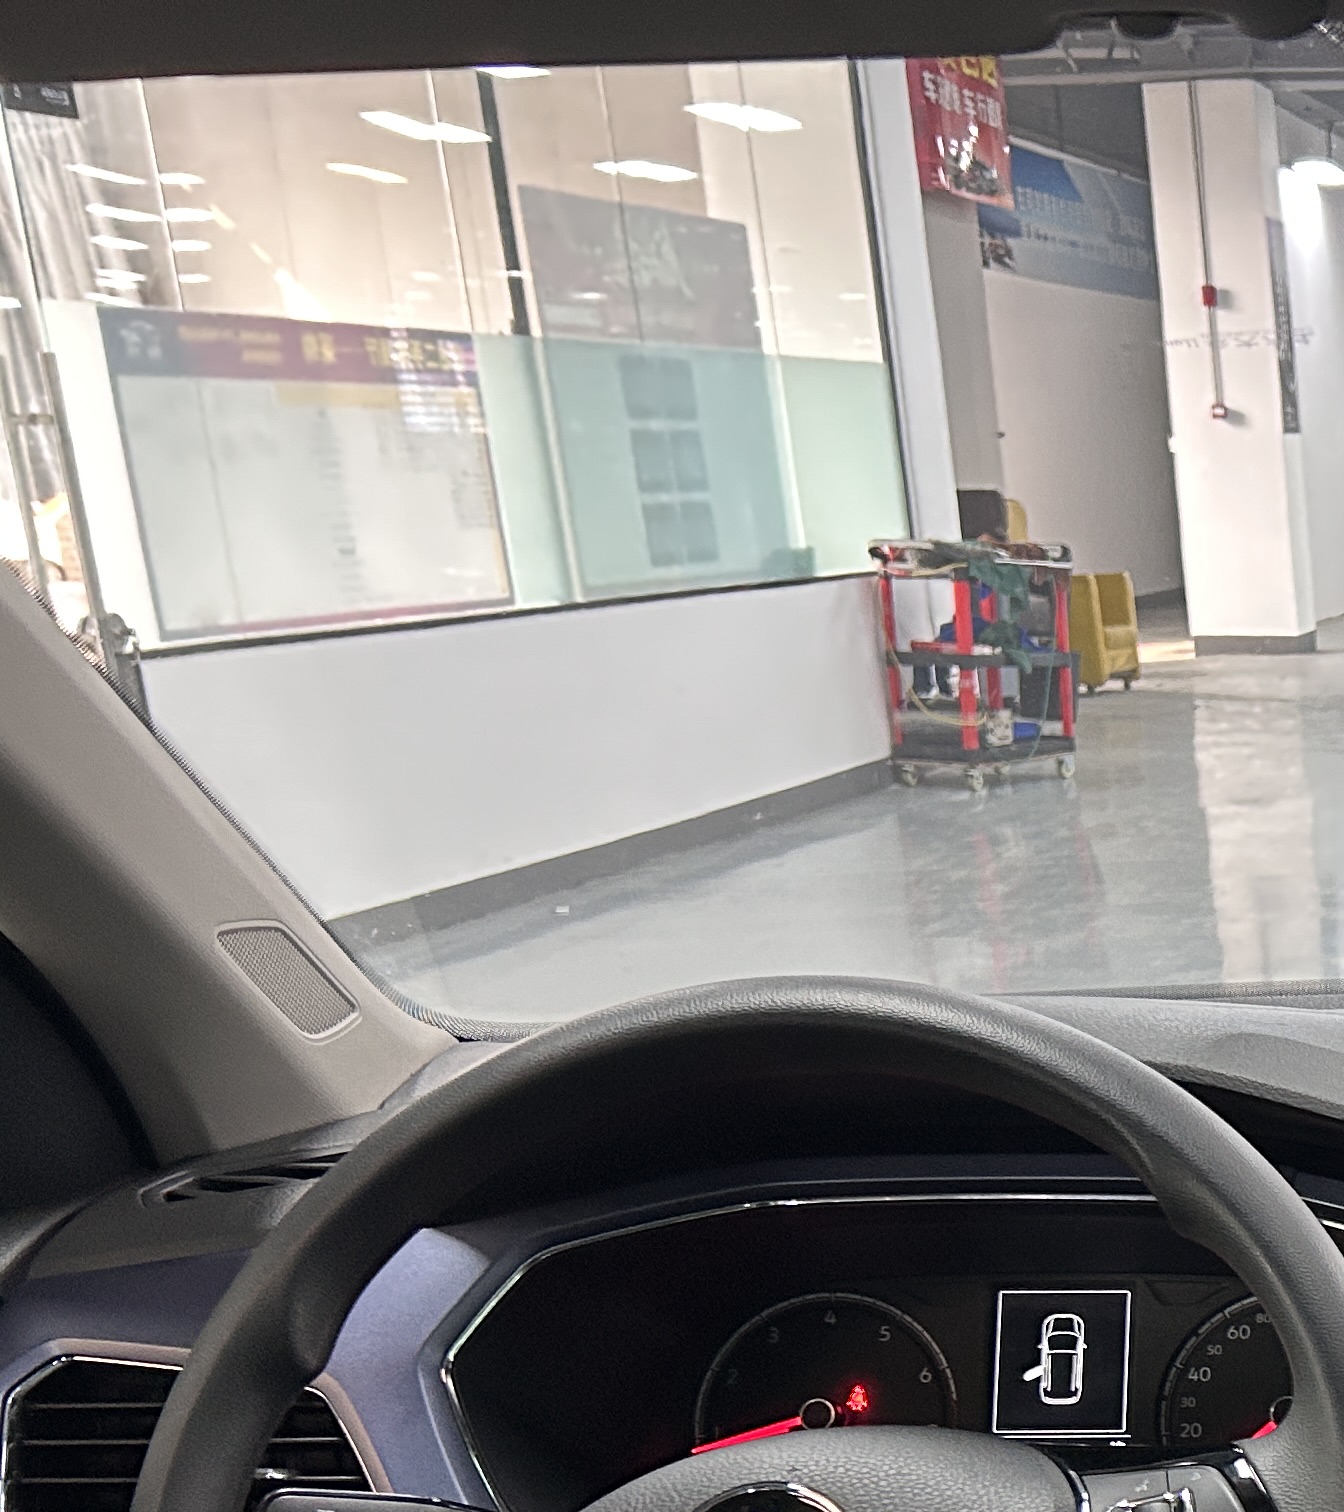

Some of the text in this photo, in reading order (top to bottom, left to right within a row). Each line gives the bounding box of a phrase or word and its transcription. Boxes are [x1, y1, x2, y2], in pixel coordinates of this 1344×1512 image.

[878, 1325, 891, 1342] 5
[1227, 1325, 1251, 1340] 60
[1206, 1344, 1223, 1356] 50
[919, 1368, 932, 1384] 6
[1188, 1366, 1212, 1382] 40
[1180, 1422, 1203, 1438] 20
